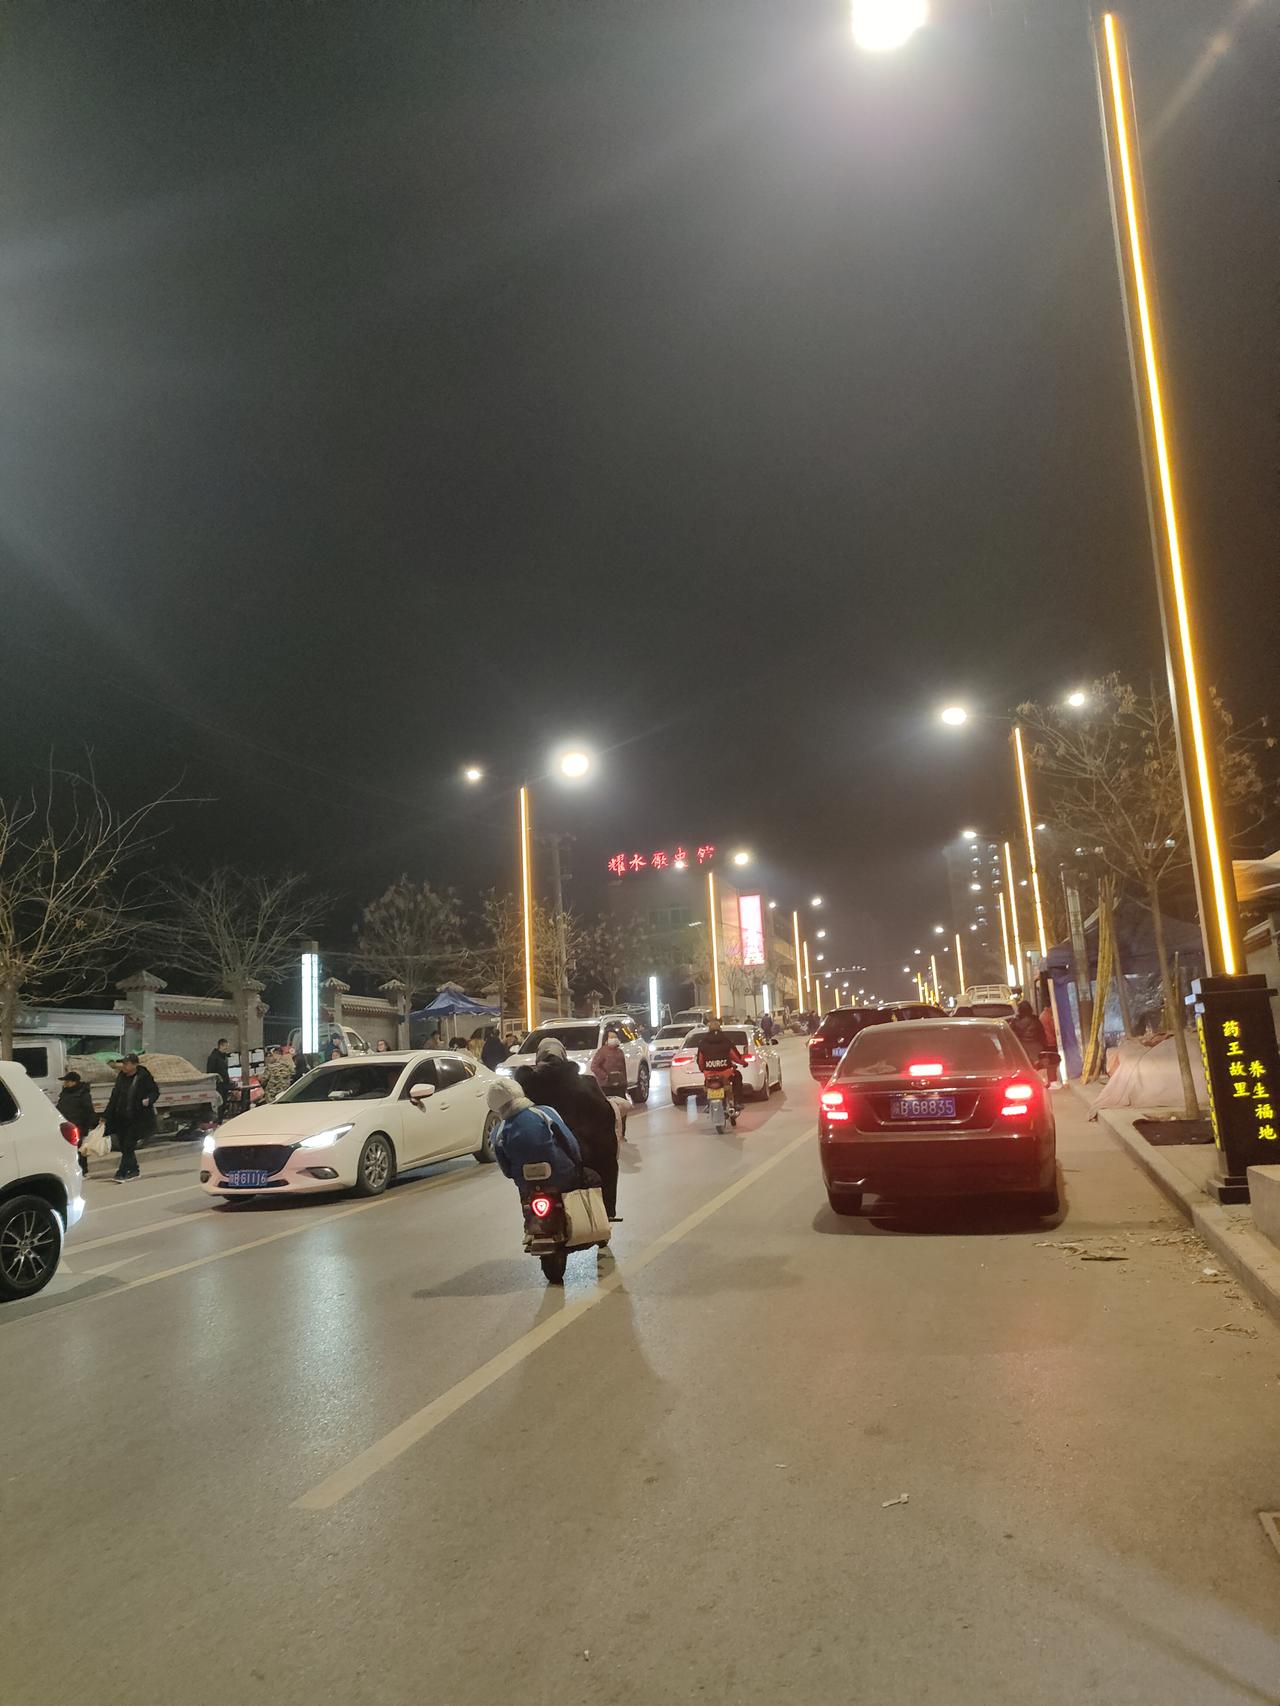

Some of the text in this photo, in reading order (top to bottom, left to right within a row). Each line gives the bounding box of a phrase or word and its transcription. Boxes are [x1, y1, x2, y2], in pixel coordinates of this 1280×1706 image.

[1222, 1020, 1251, 1098] 药王故里
[1248, 1060, 1278, 1140] 养生福地
